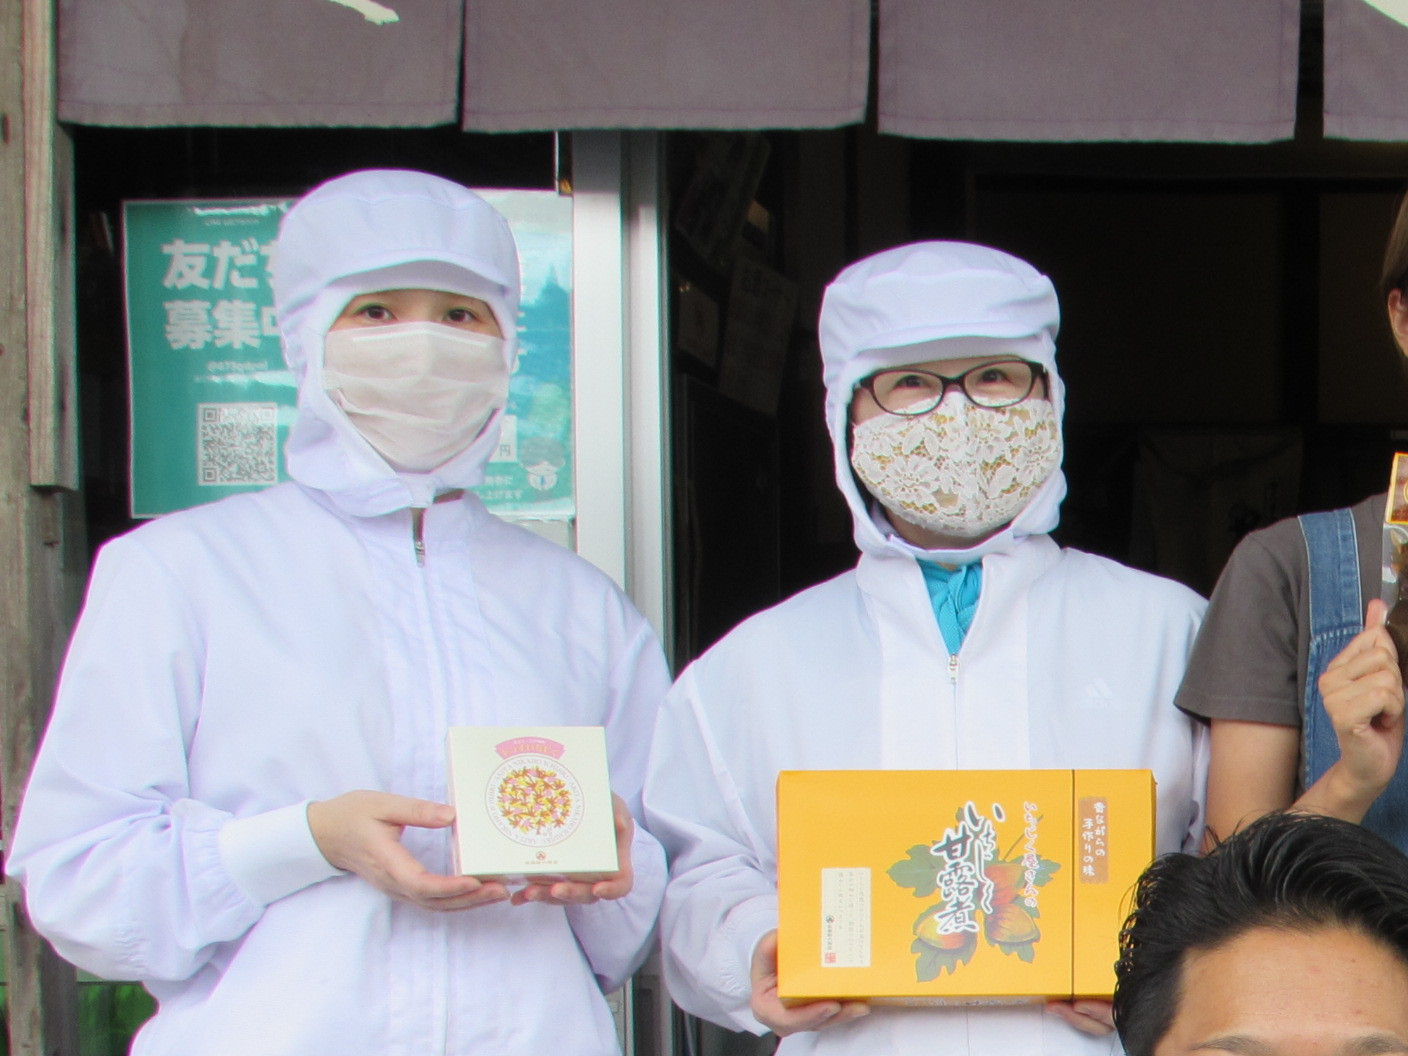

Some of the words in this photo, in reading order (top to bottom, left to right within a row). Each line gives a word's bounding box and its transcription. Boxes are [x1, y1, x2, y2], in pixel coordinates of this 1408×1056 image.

[1094, 802, 1106, 857] 昔ながらの
